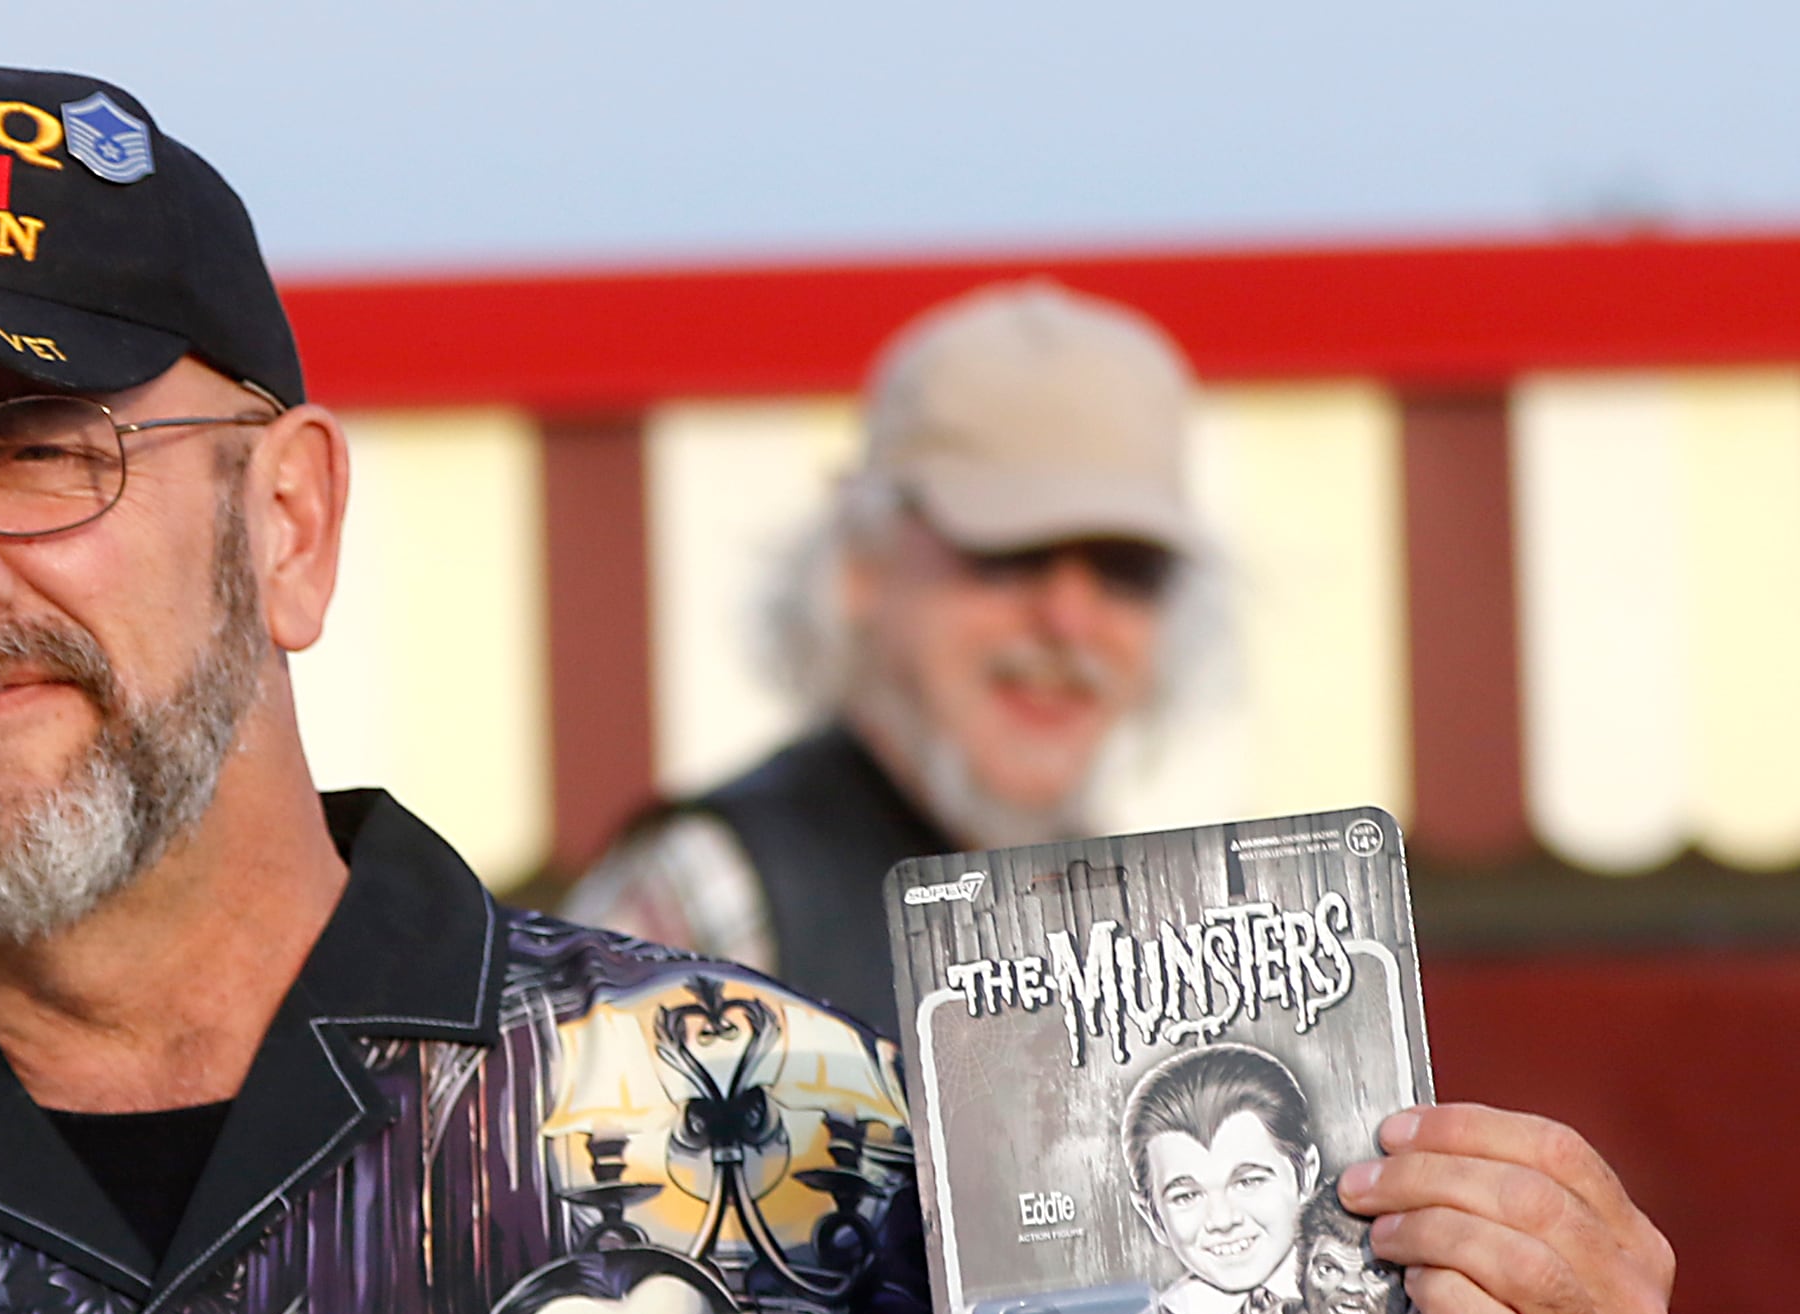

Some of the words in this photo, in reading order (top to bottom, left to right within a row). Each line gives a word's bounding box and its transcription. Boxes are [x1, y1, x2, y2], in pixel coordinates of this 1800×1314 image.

[1351, 835, 1378, 850] 14+
[947, 955, 1052, 1017] THE
[1046, 892, 1353, 1067] MUNSTERS
[1019, 1191, 1075, 1225] Eddie
[1018, 1231, 1051, 1243] ACTION
